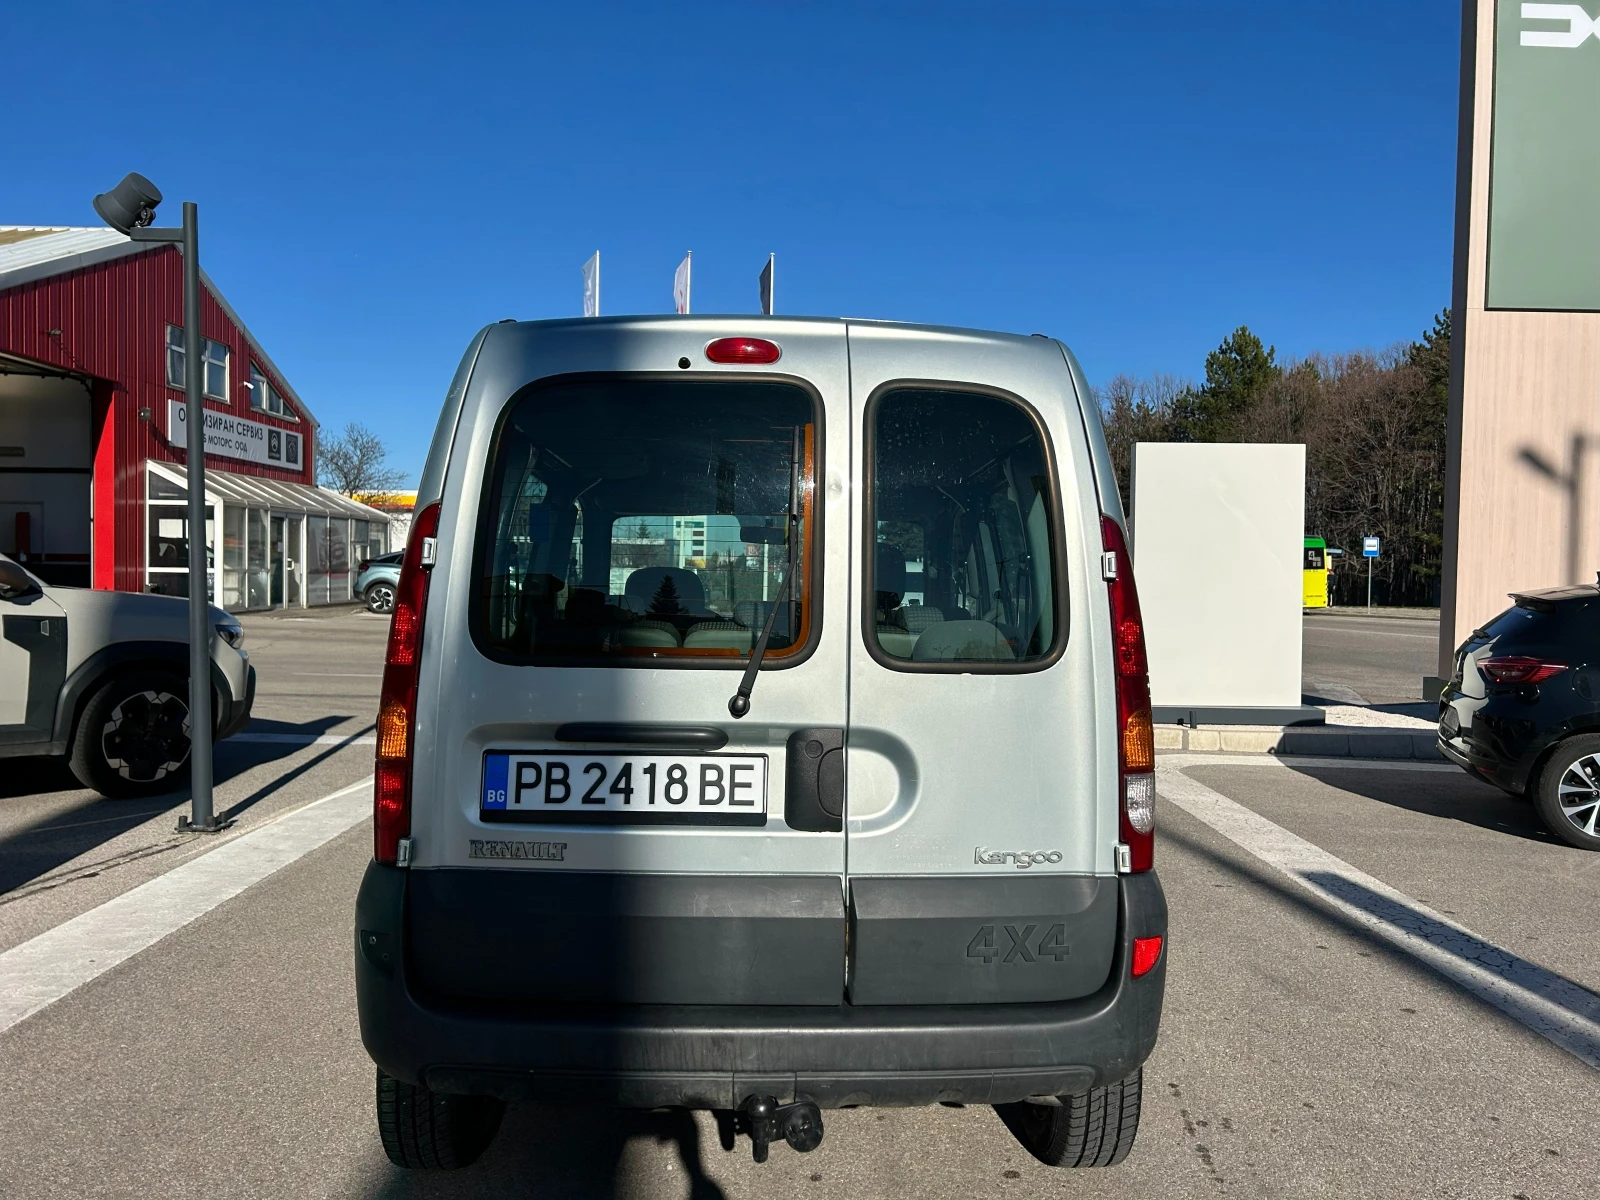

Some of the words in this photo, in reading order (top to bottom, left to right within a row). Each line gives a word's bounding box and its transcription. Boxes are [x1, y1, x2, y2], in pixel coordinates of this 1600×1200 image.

[178, 407, 234, 434] ОИЗИРАН
[236, 422, 264, 440] СЕРВИЗ
[207, 435, 233, 449] МОТОРС
[234, 441, 248, 453] ООД
[513, 761, 571, 804] PB
[581, 762, 689, 806] 2418
[699, 763, 755, 807] BE
[487, 789, 505, 803] BG
[469, 839, 568, 862] RENAULT
[974, 846, 1063, 869] Kangoo
[966, 923, 1070, 964] 4X4
